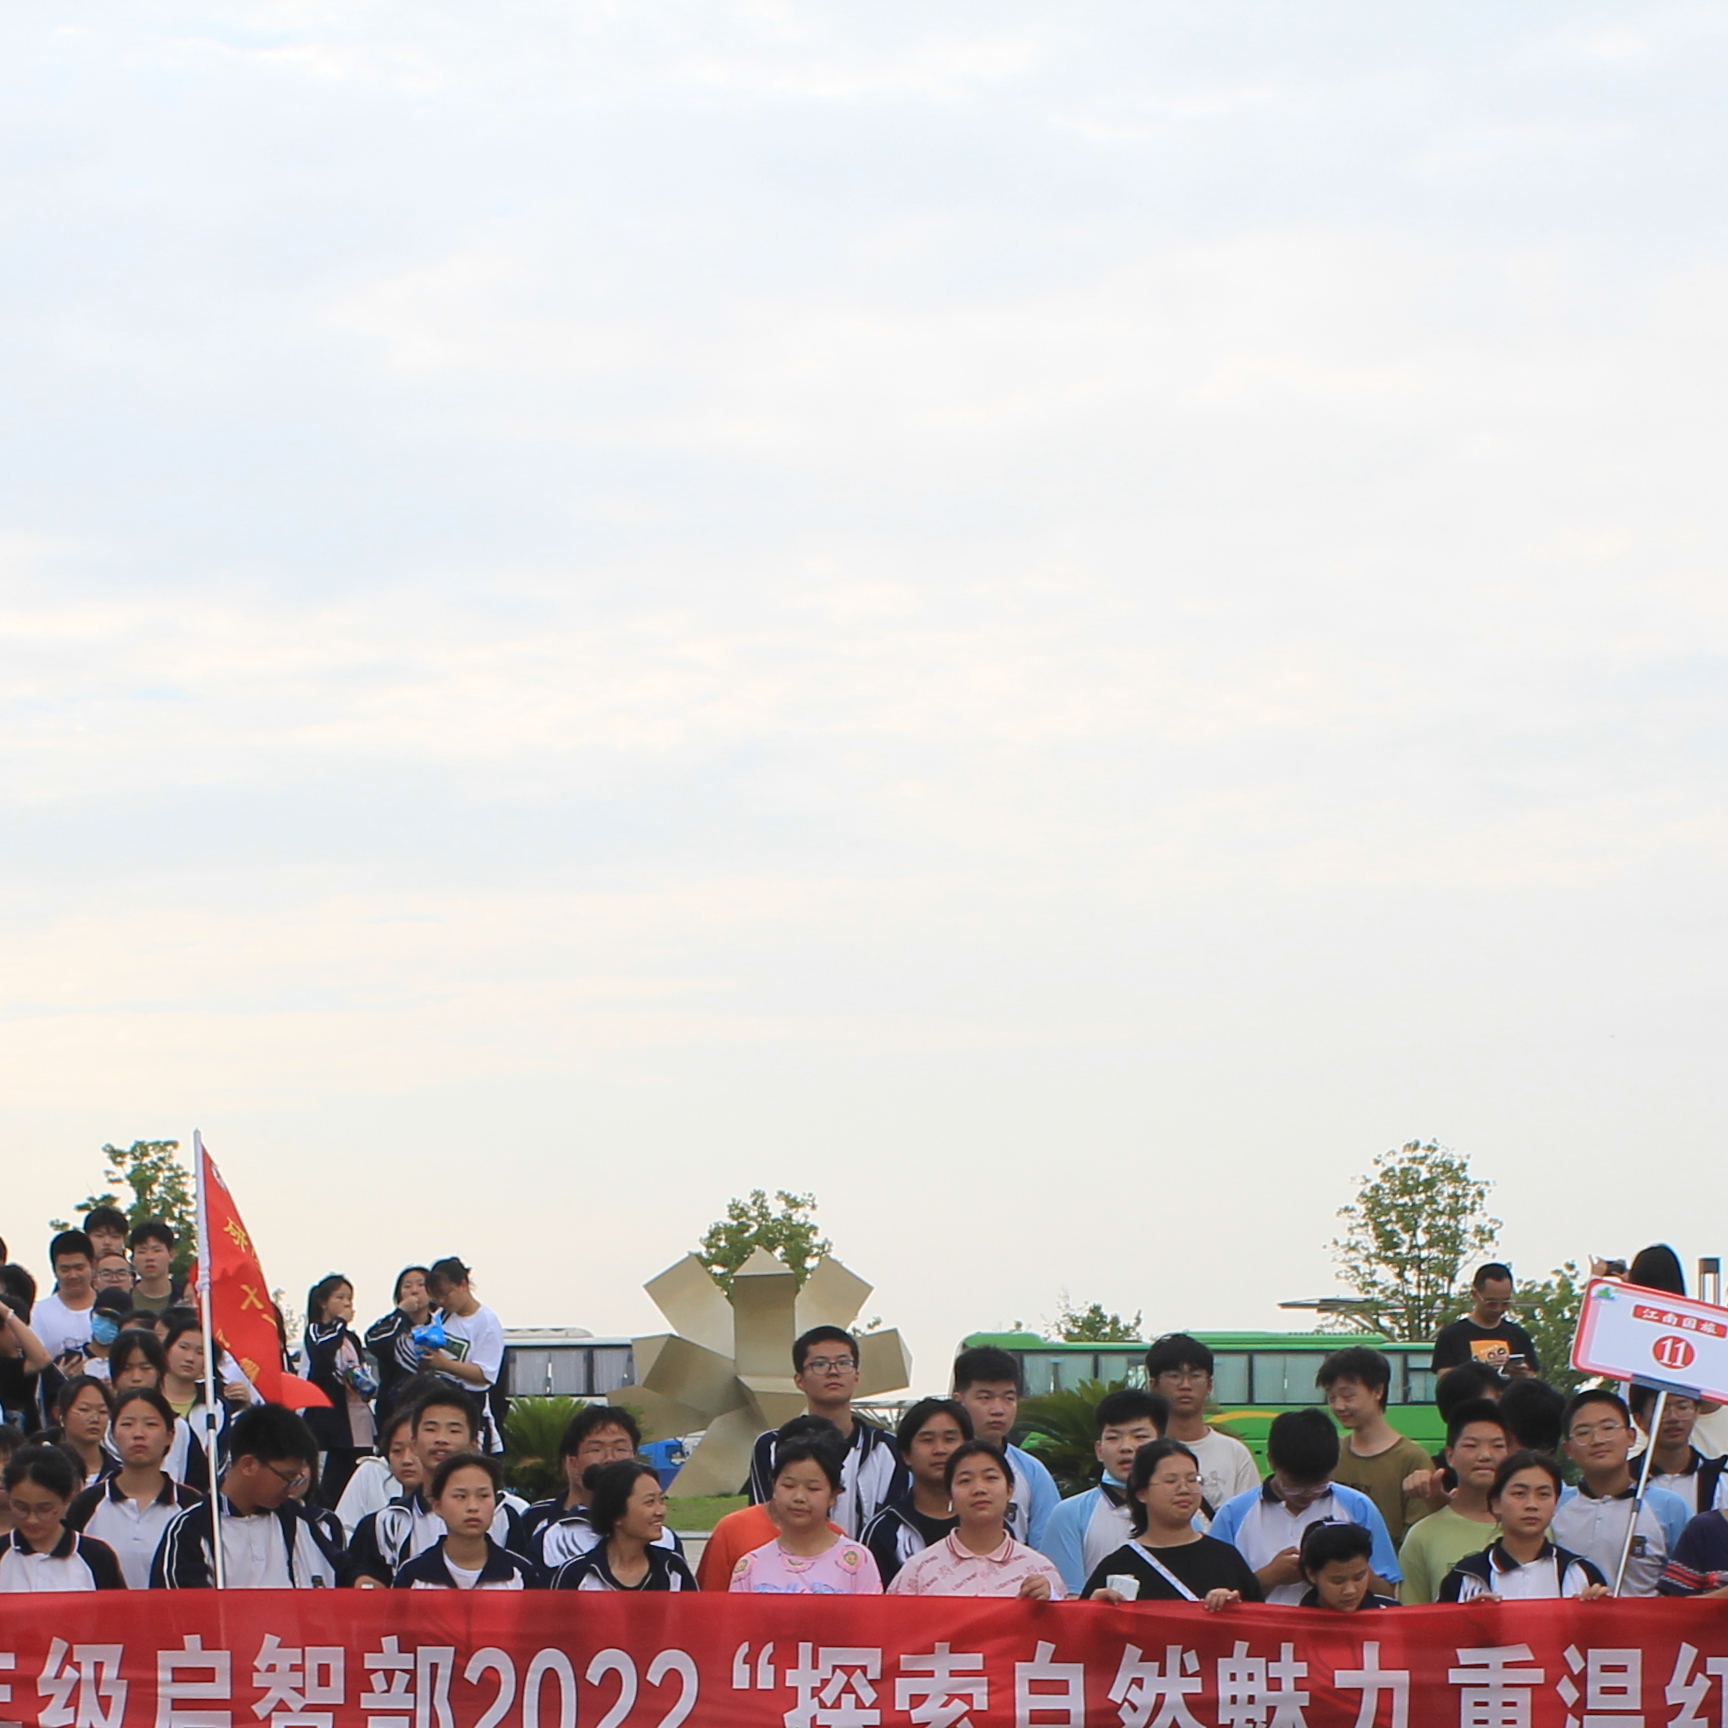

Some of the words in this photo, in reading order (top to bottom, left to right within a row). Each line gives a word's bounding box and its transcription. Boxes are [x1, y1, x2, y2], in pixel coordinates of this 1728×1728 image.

[1641, 1308, 1718, 1335] 江南国旅
[1658, 1338, 1687, 1367] 11
